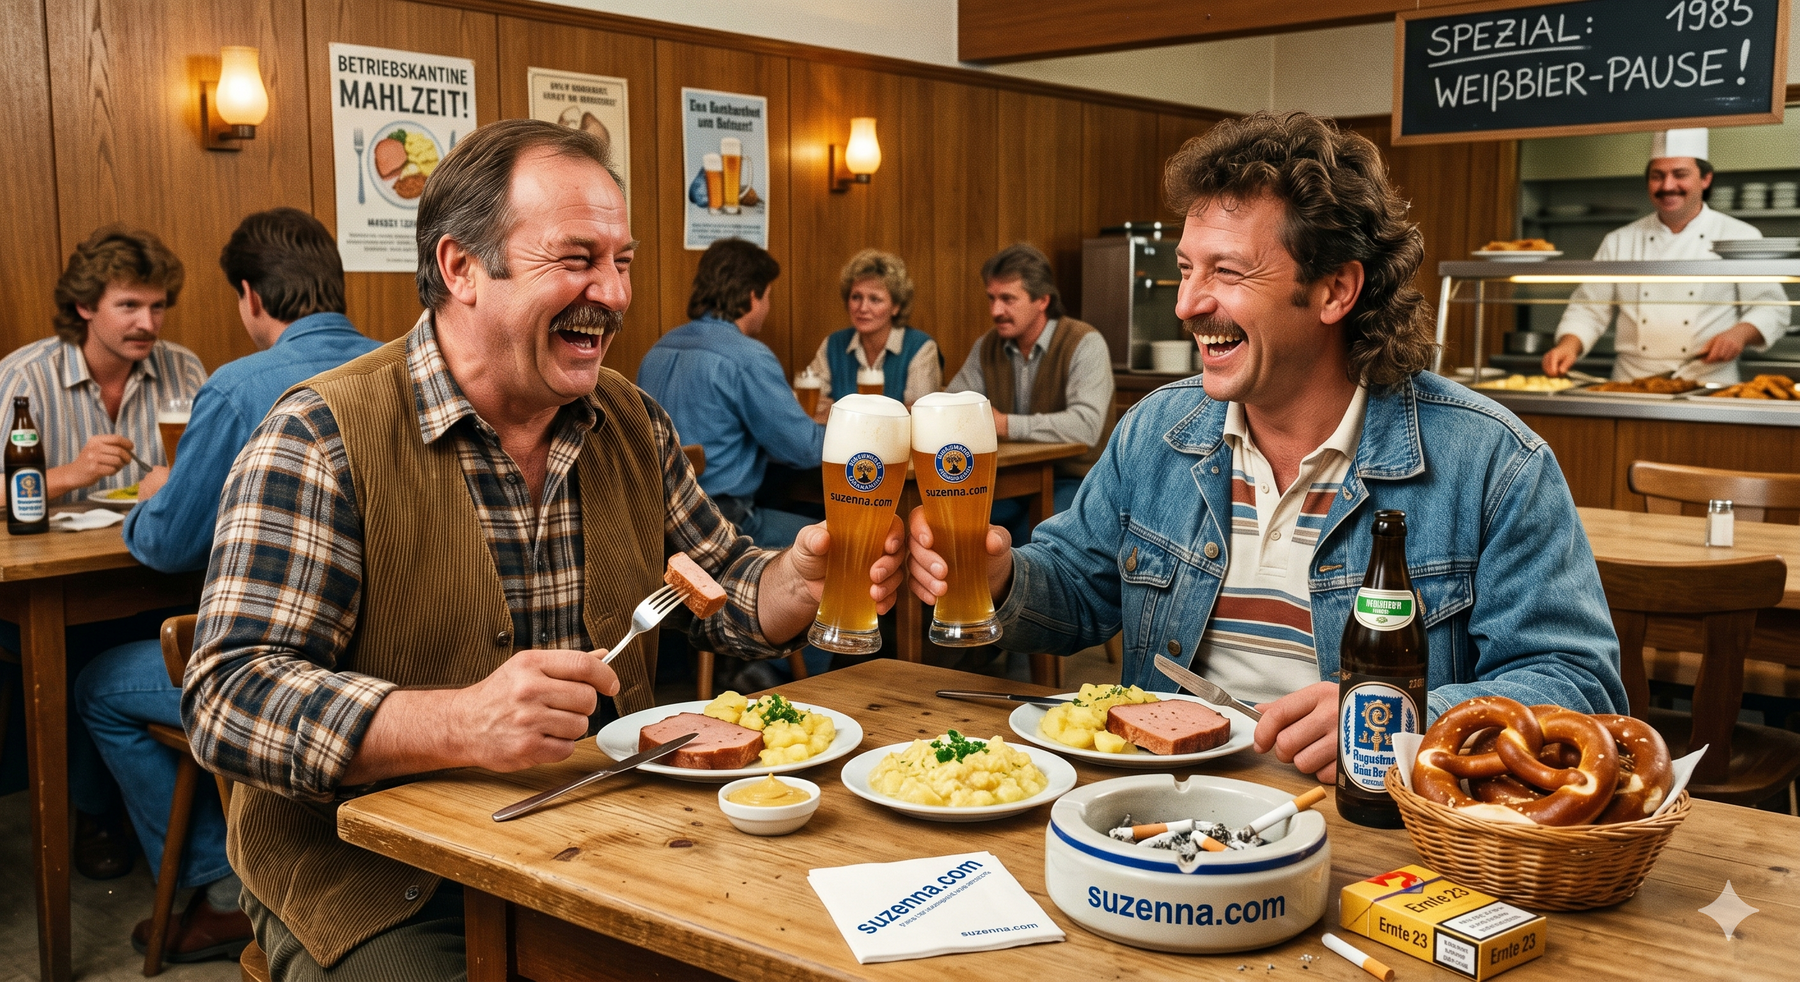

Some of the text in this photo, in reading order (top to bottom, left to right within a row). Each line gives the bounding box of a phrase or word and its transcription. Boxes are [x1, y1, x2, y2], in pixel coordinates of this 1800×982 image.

[1665, 0, 1754, 32] 1985
[1427, 14, 1594, 56] SPEZIAL:
[338, 55, 468, 86] BETRIEBSKANTINE
[339, 79, 469, 118] MAHLZEIT!
[830, 491, 893, 507] suzenna.com
[925, 485, 988, 497] suzenna.com
[857, 859, 984, 935] suzenna.com
[1088, 885, 1286, 926] suzenna.com
[1404, 887, 1470, 913] Ernte 23
[961, 921, 1039, 937] suzenna.com
[1379, 916, 1410, 942] Ernte
[1412, 930, 1428, 949] 23
[1490, 942, 1520, 966] Ernte
[1522, 932, 1536, 953] 23
